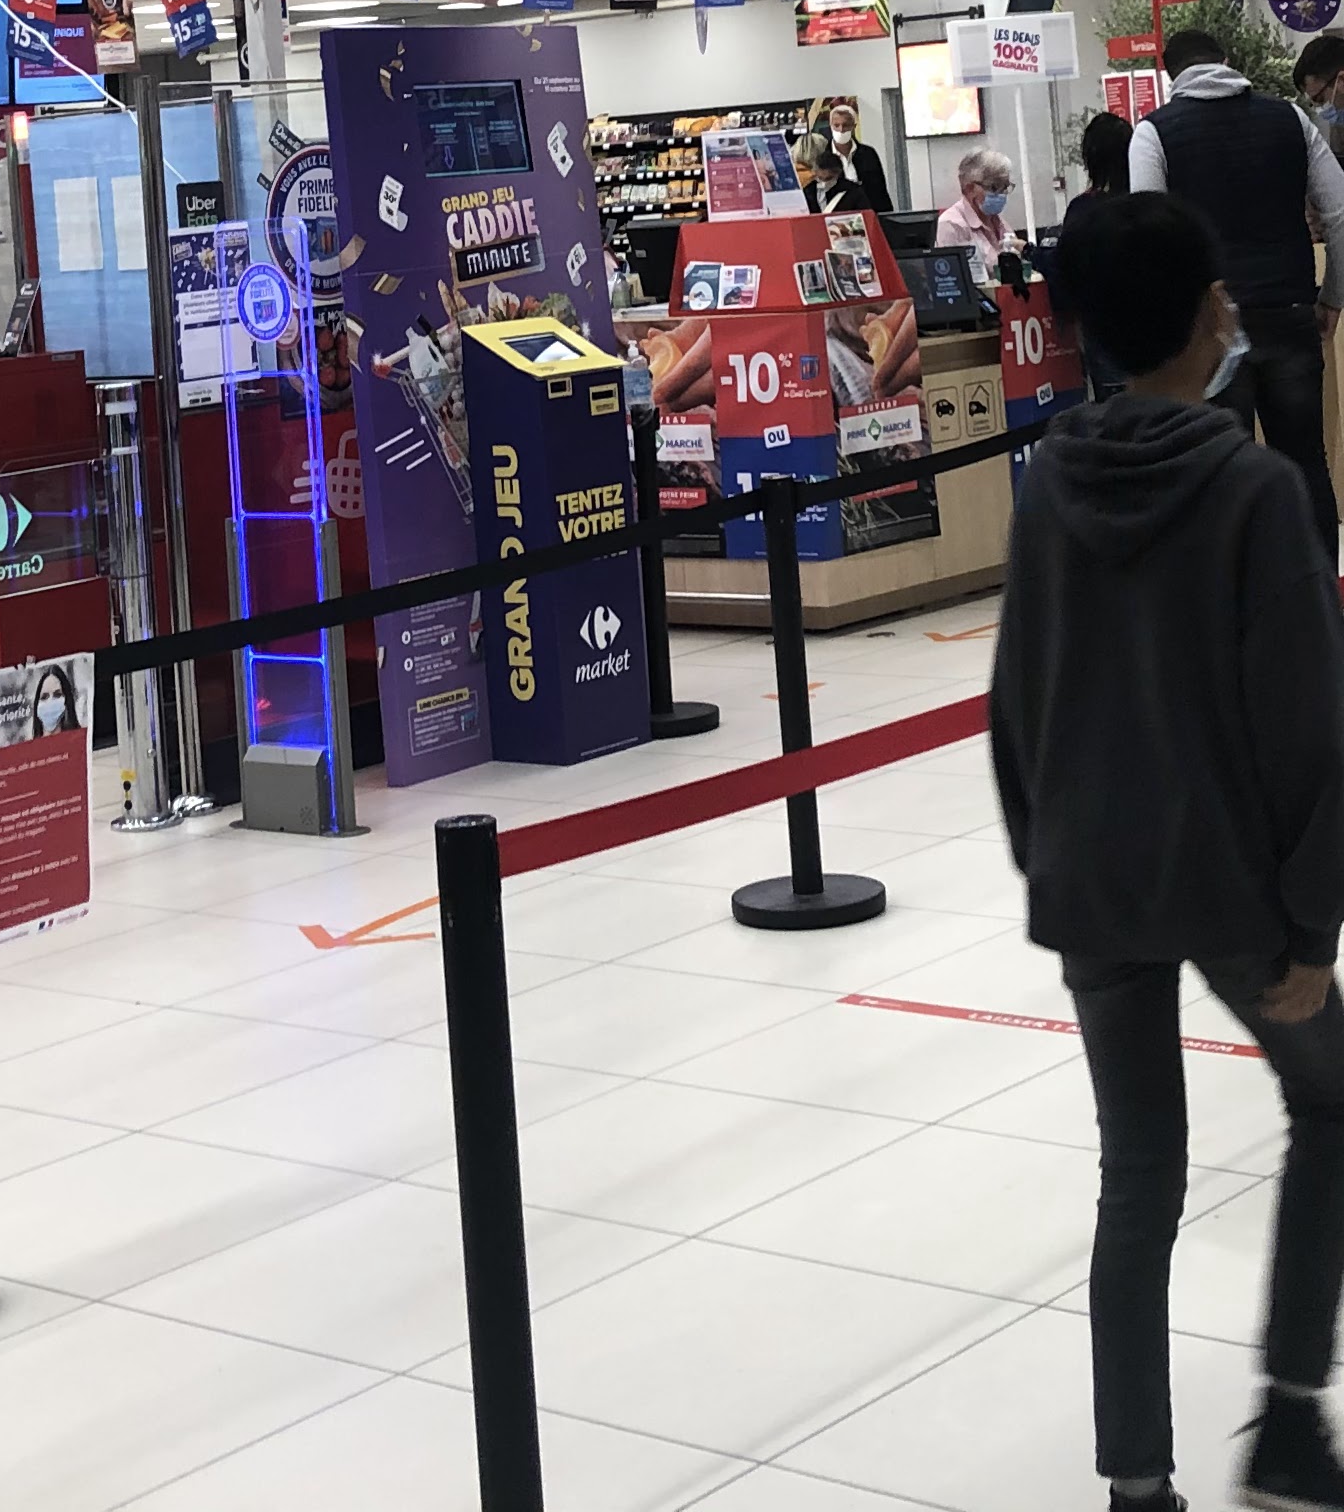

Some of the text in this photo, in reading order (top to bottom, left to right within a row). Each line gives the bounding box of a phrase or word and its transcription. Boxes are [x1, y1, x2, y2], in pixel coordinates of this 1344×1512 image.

[53, 26, 85, 37] NIQUE
[994, 28, 1040, 46] LES DEALS
[992, 59, 1039, 73] GAGNANTS
[993, 43, 1038, 63] 100%
[280, 167, 297, 193] VOUS
[298, 155, 318, 174] AVEZ
[299, 179, 335, 196] PRIME
[185, 196, 217, 211] Uber
[441, 186, 514, 214] GRAND JEU
[446, 198, 541, 250] CADDIE
[466, 241, 532, 275] MINUTE
[767, 429, 786, 444] OU
[492, 445, 524, 529] JEU
[556, 483, 624, 516] TENTEZ
[558, 508, 626, 543] VOTRE
[575, 648, 631, 684] market
